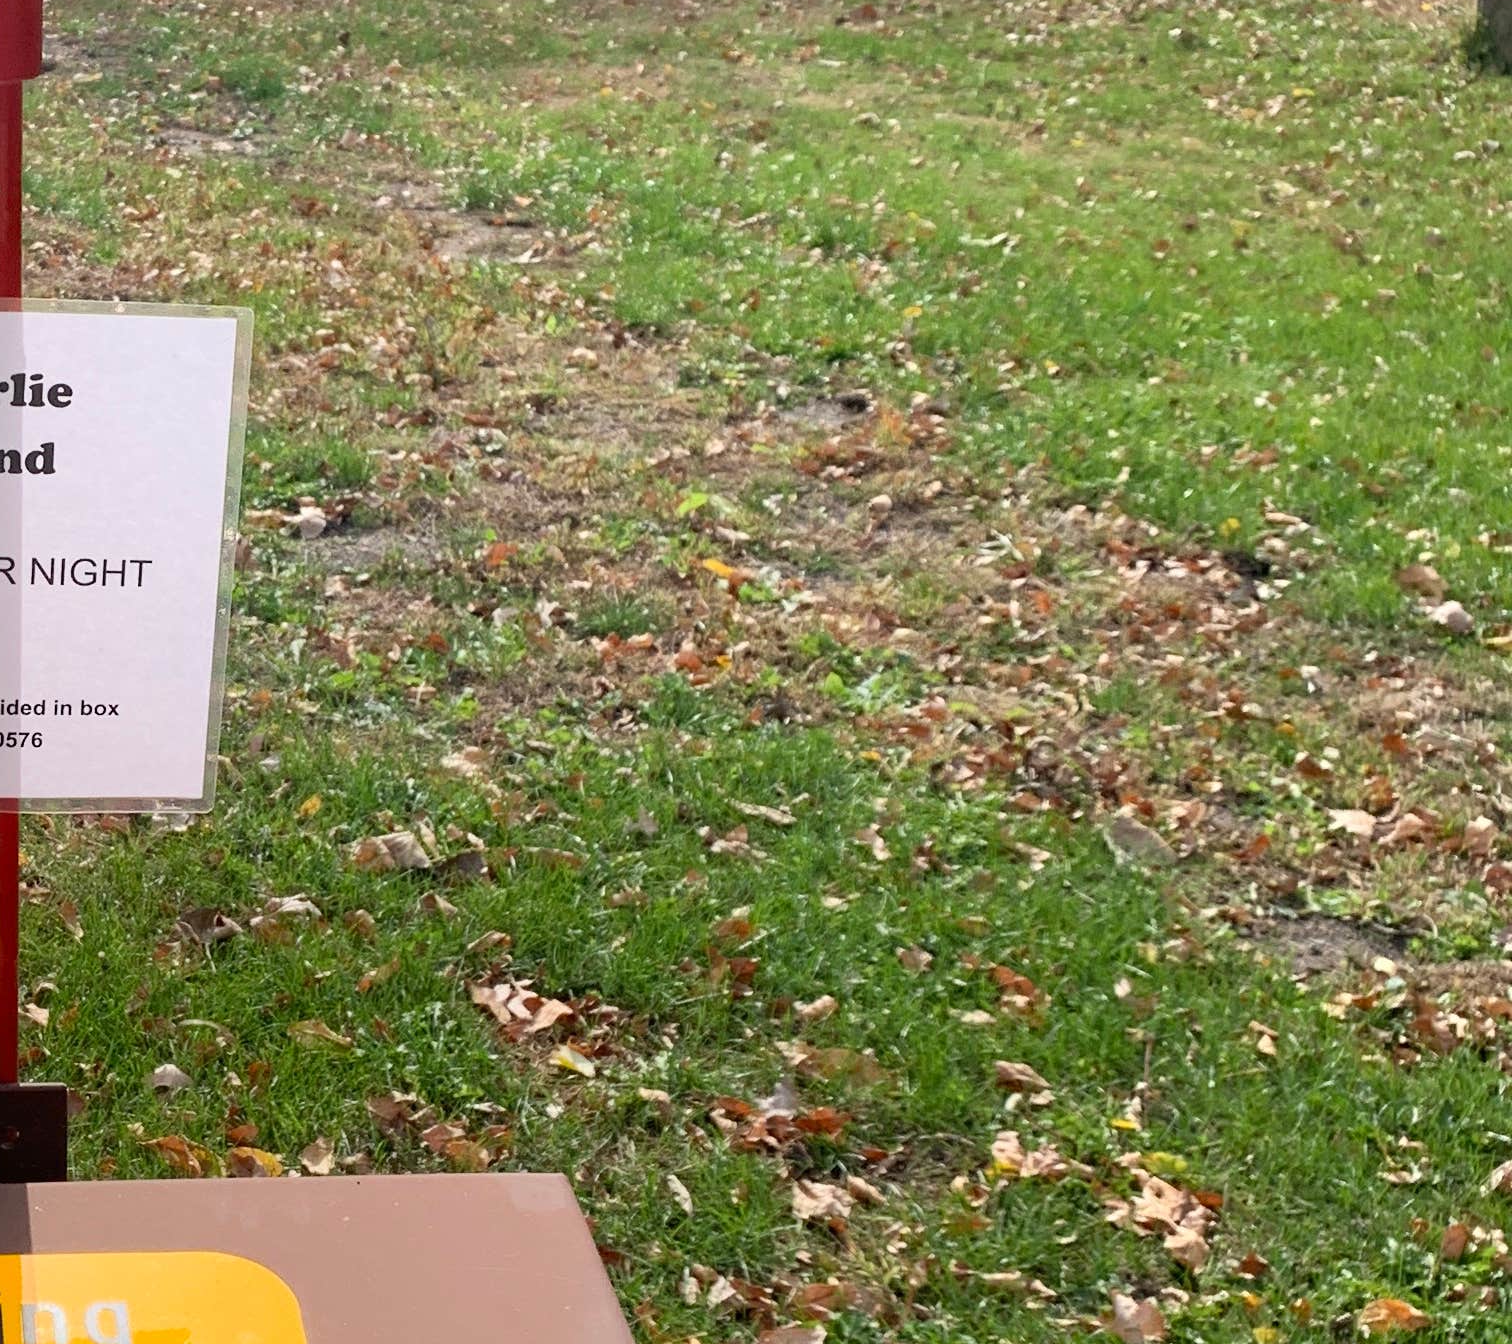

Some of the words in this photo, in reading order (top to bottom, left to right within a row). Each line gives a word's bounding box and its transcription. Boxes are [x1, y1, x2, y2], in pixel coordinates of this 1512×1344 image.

[30, 556, 153, 588] NIGHT
[54, 699, 73, 717] in
[80, 700, 120, 717] box
